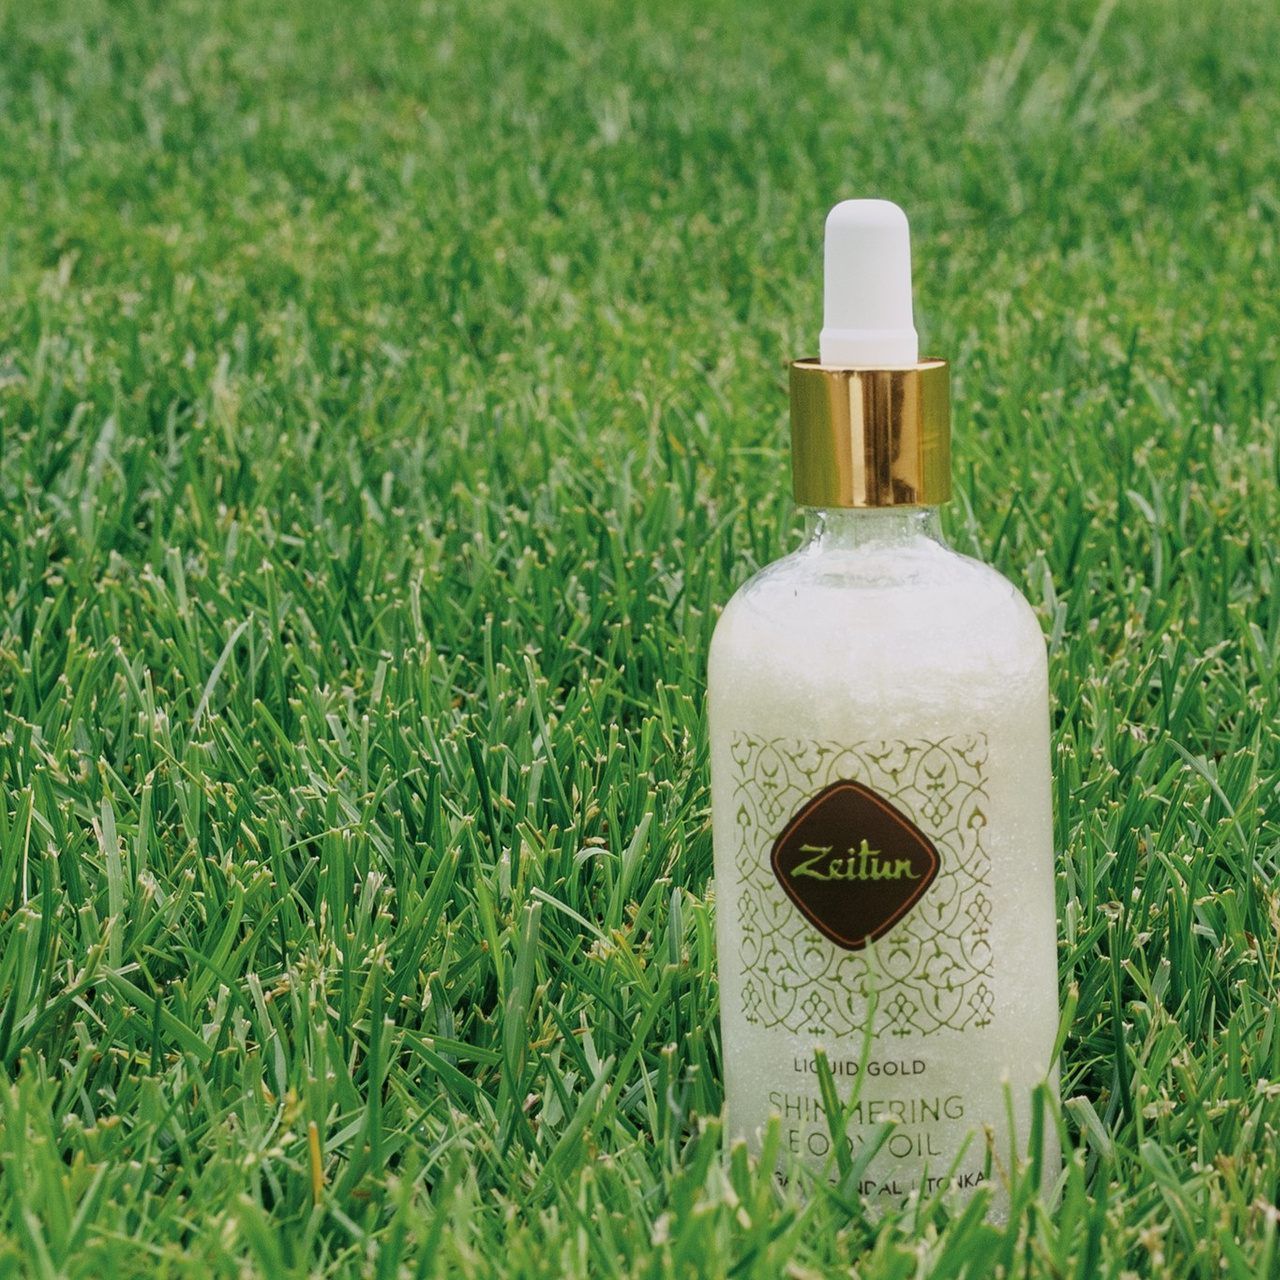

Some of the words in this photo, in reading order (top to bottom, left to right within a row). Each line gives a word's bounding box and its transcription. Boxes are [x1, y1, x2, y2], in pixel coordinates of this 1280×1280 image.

[790, 839, 921, 880] Zeitun
[867, 1060, 926, 1076] GOLD
[889, 1132, 942, 1158] OIL
